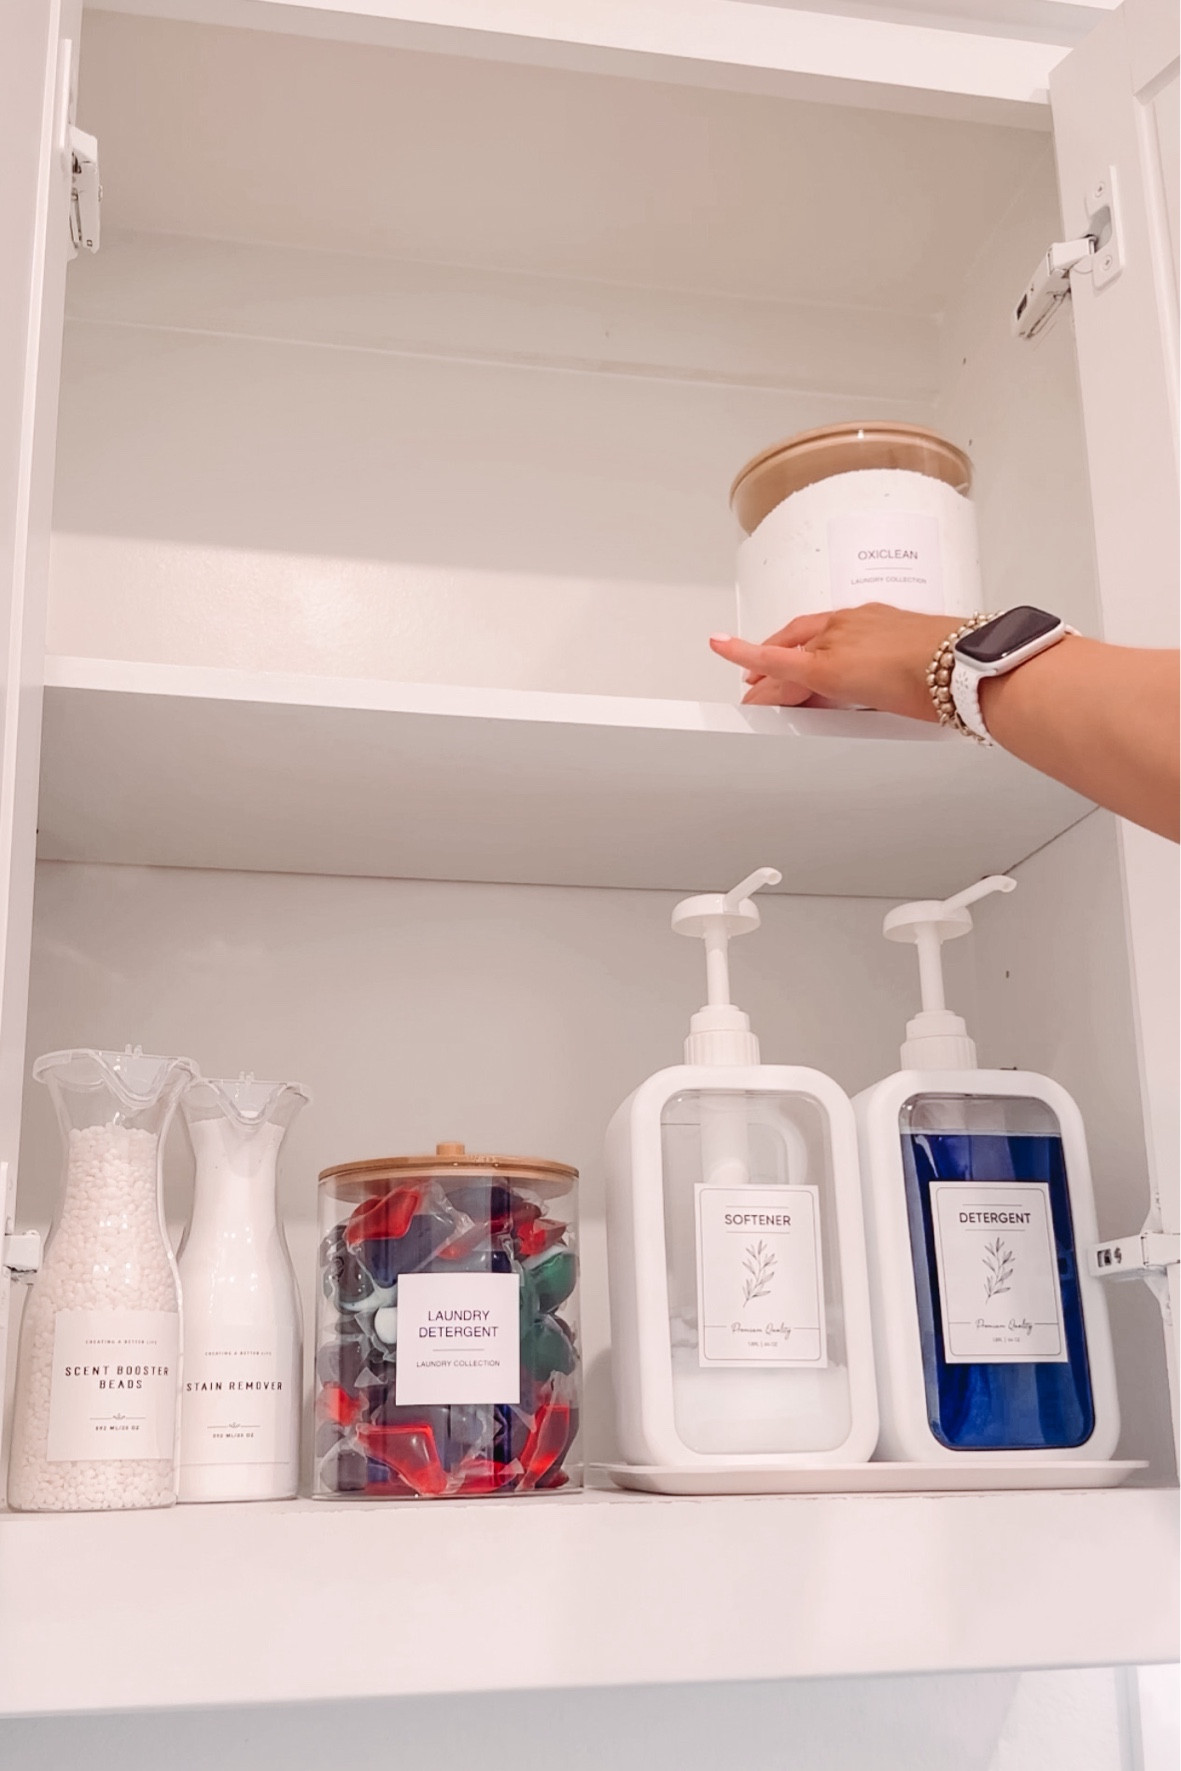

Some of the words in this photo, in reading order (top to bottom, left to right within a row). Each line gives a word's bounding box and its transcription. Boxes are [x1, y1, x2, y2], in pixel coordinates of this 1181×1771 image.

[857, 549, 918, 561] OXICLEAN
[850, 577, 884, 585] LAUNDRY
[885, 576, 927, 584] COLLECTION
[724, 1213, 791, 1226] SOFTENER
[959, 1212, 1031, 1224] DETERGENT
[428, 1310, 490, 1321] LAUNDRY
[418, 1326, 499, 1338] DETERGENT
[765, 1321, 791, 1341] Quality
[1007, 1318, 1033, 1336] Quality
[416, 1360, 452, 1368] LAUNDRY
[65, 1365, 109, 1377] SCENT
[117, 1365, 169, 1376] BOOSTER
[99, 1379, 143, 1389] BEADS
[186, 1381, 223, 1392] STAIN
[229, 1381, 283, 1391] REMOVER
